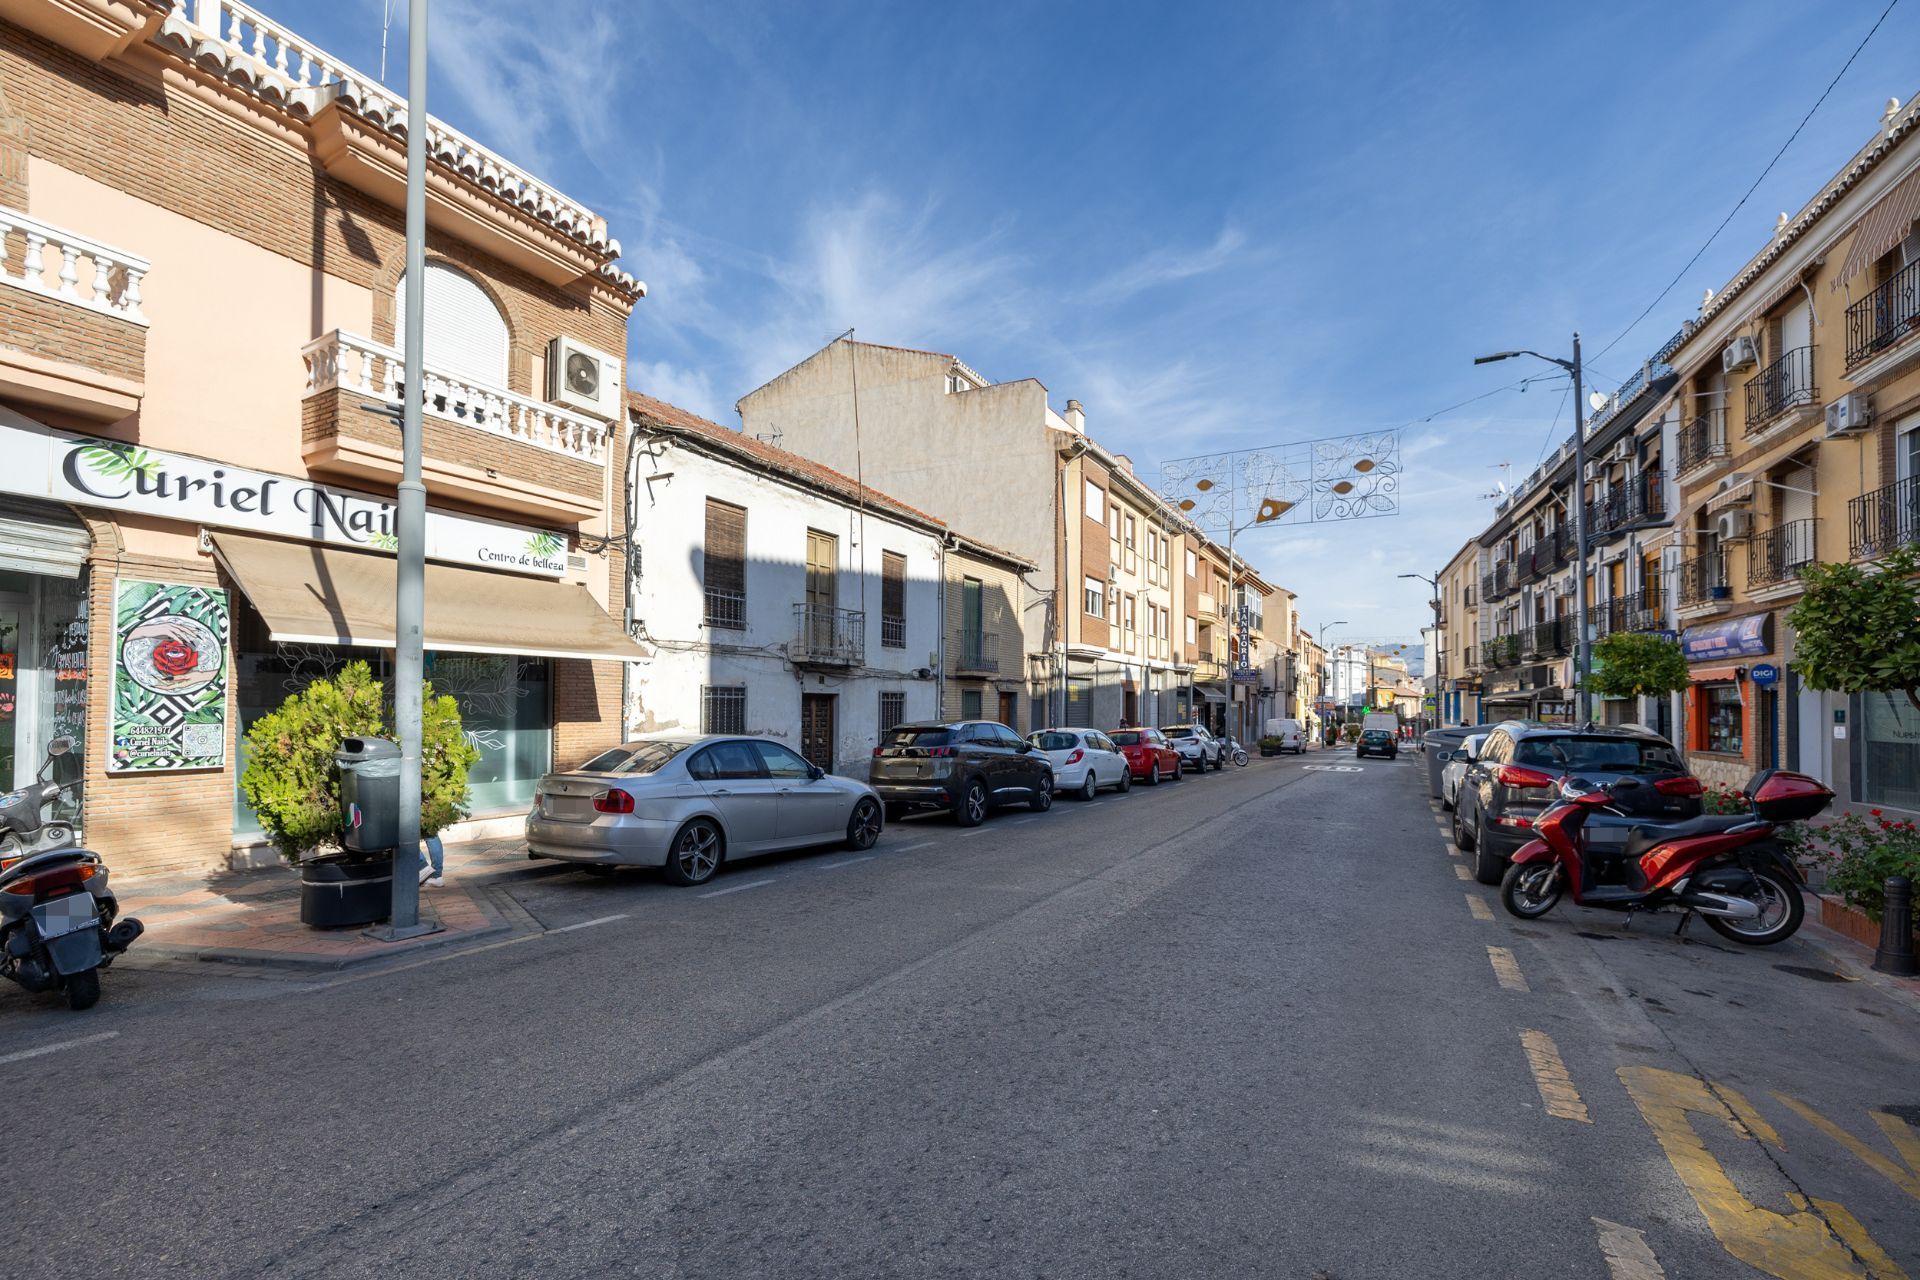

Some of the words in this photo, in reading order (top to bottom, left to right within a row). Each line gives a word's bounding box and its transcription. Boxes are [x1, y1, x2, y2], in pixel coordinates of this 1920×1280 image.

[62, 445, 279, 516] Curiel
[293, 486, 399, 543] Nail
[478, 547, 516, 564] Centro
[518, 554, 530, 566] de
[533, 556, 564, 572] belleza
[1753, 669, 1774, 677] DIGI
[130, 726, 171, 735] 644821977
[130, 738, 151, 746] Curiel
[152, 738, 168, 746] Nails
[129, 749, 171, 758] @curielnails
